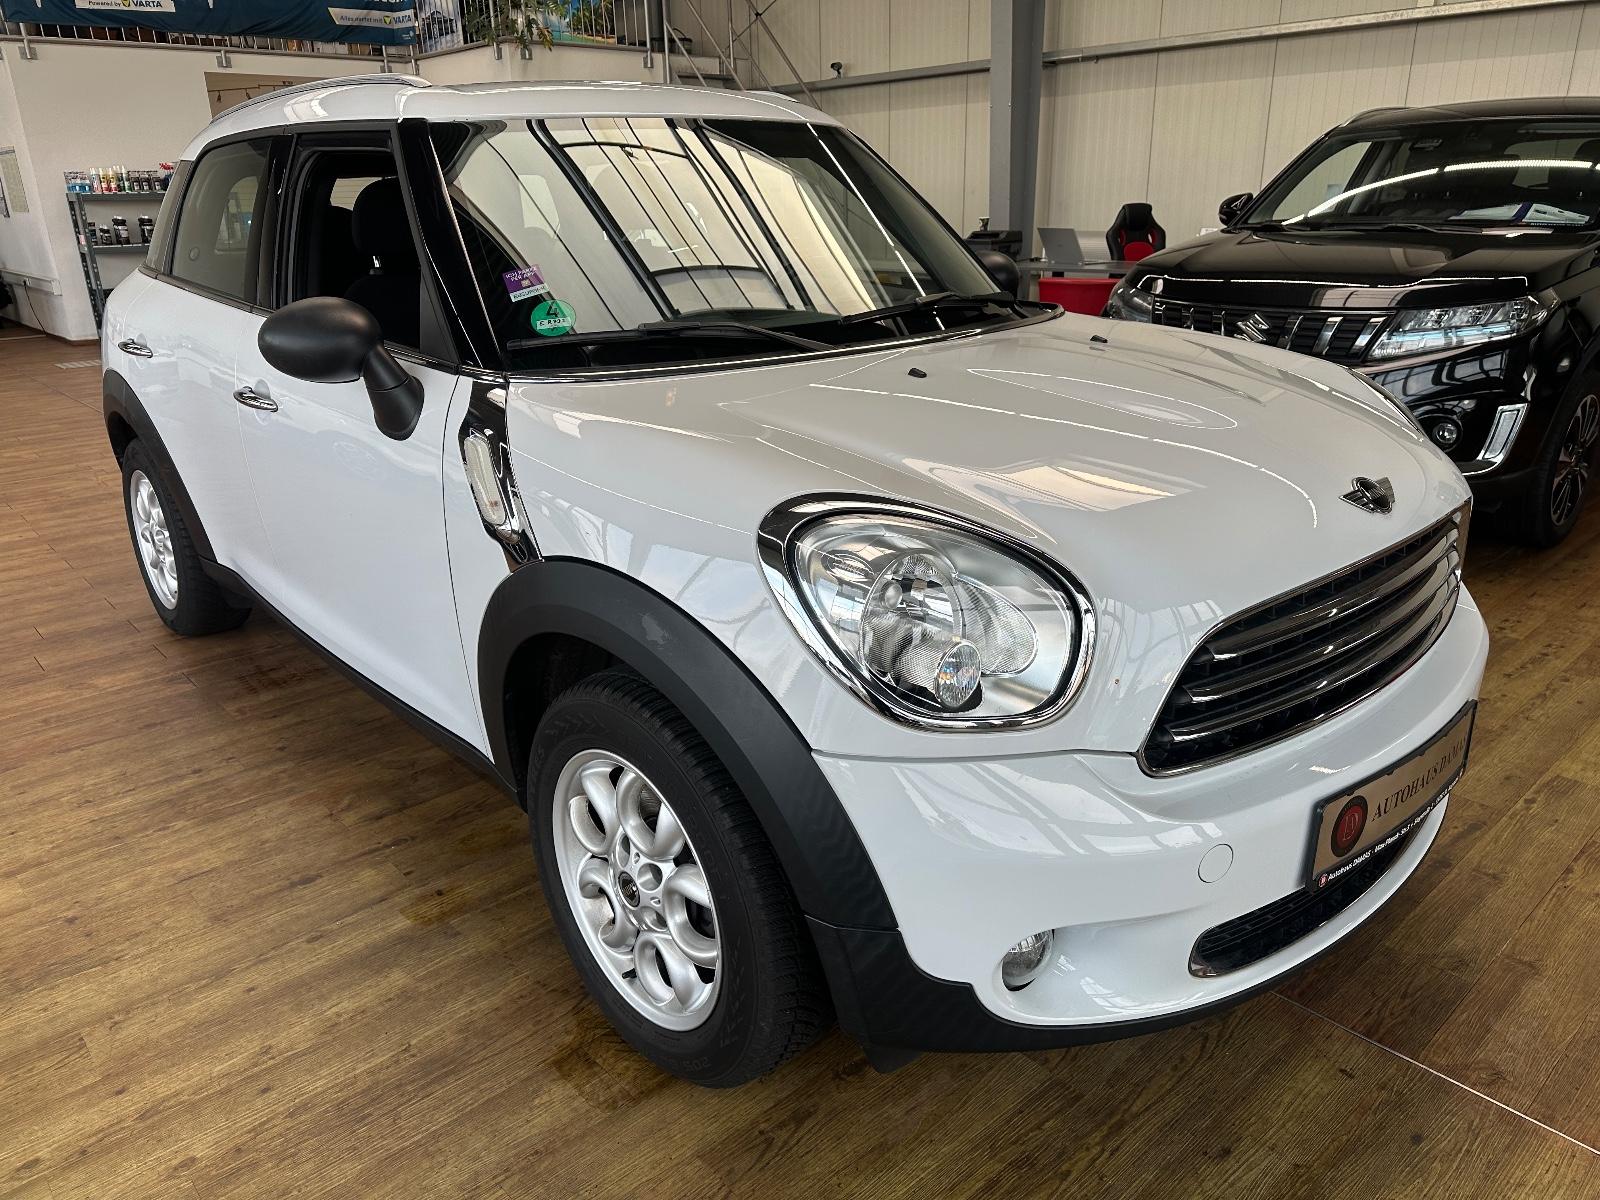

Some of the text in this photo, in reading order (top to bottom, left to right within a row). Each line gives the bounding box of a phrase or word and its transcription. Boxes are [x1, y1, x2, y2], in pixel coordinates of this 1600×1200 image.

[131, 0, 163, 8] VARTA
[393, 14, 411, 24] VARTA
[1372, 762, 1439, 822] AUTOHAUS
